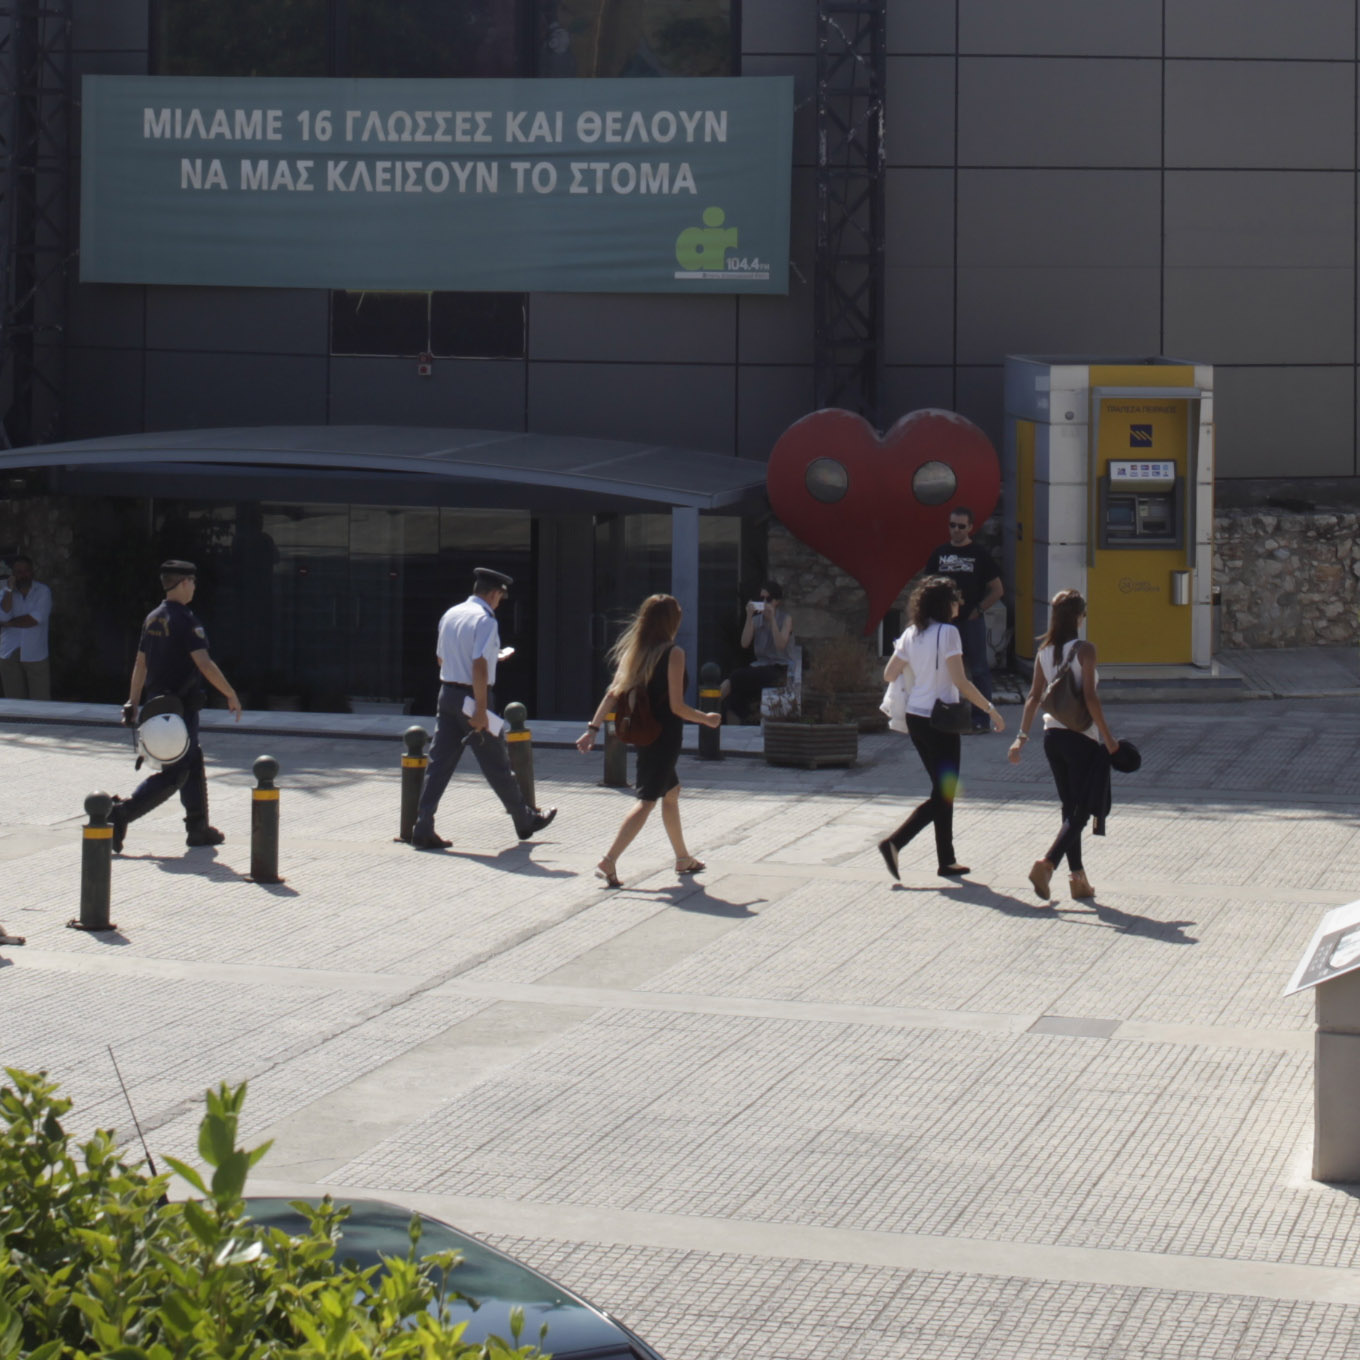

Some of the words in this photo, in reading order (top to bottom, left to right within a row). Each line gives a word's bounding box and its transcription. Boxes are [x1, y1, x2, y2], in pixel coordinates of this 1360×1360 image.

[143, 108, 283, 141] ΜΙΛΑΜΕ
[297, 110, 332, 142] 16
[345, 110, 493, 143] ΓΛΩΣΣΕΣ
[506, 111, 563, 143] ΚΑΙ
[576, 110, 727, 143] ΘΕΛΟΥΝ
[180, 158, 228, 190] ΝΑ
[240, 159, 314, 191] ΜΑΣ
[326, 160, 498, 193] ΚΛΕΙΣΟΥΝ
[510, 161, 557, 194] ΤΟ
[569, 161, 697, 195] ΣΤΟΜΑ
[726, 257, 760, 271] 104.4
